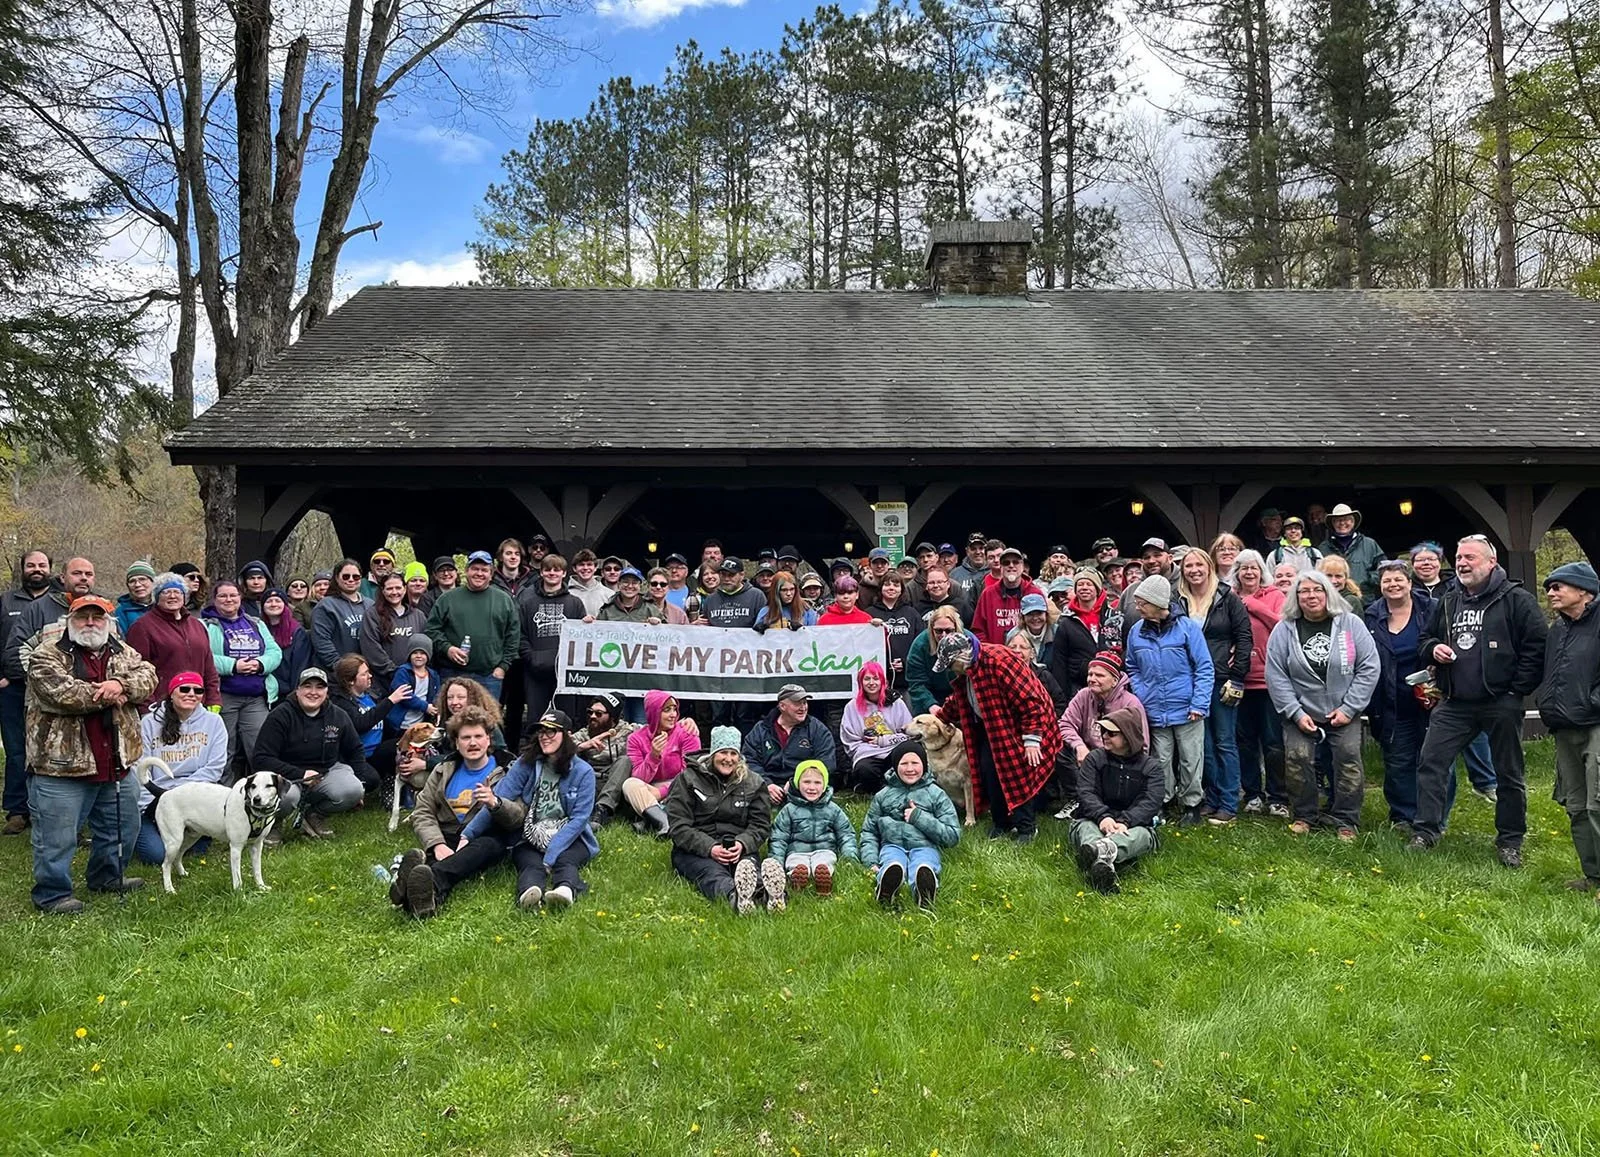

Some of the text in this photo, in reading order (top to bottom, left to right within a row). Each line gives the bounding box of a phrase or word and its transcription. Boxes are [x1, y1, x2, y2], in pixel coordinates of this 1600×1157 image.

[710, 608, 750, 618] WATKINS GLEN
[568, 628, 681, 643] Parks & Trails New York's
[567, 641, 576, 667] I
[584, 641, 659, 669] LOVE
[668, 646, 714, 673] MY
[719, 648, 795, 675] PARK
[568, 672, 589, 685] May
